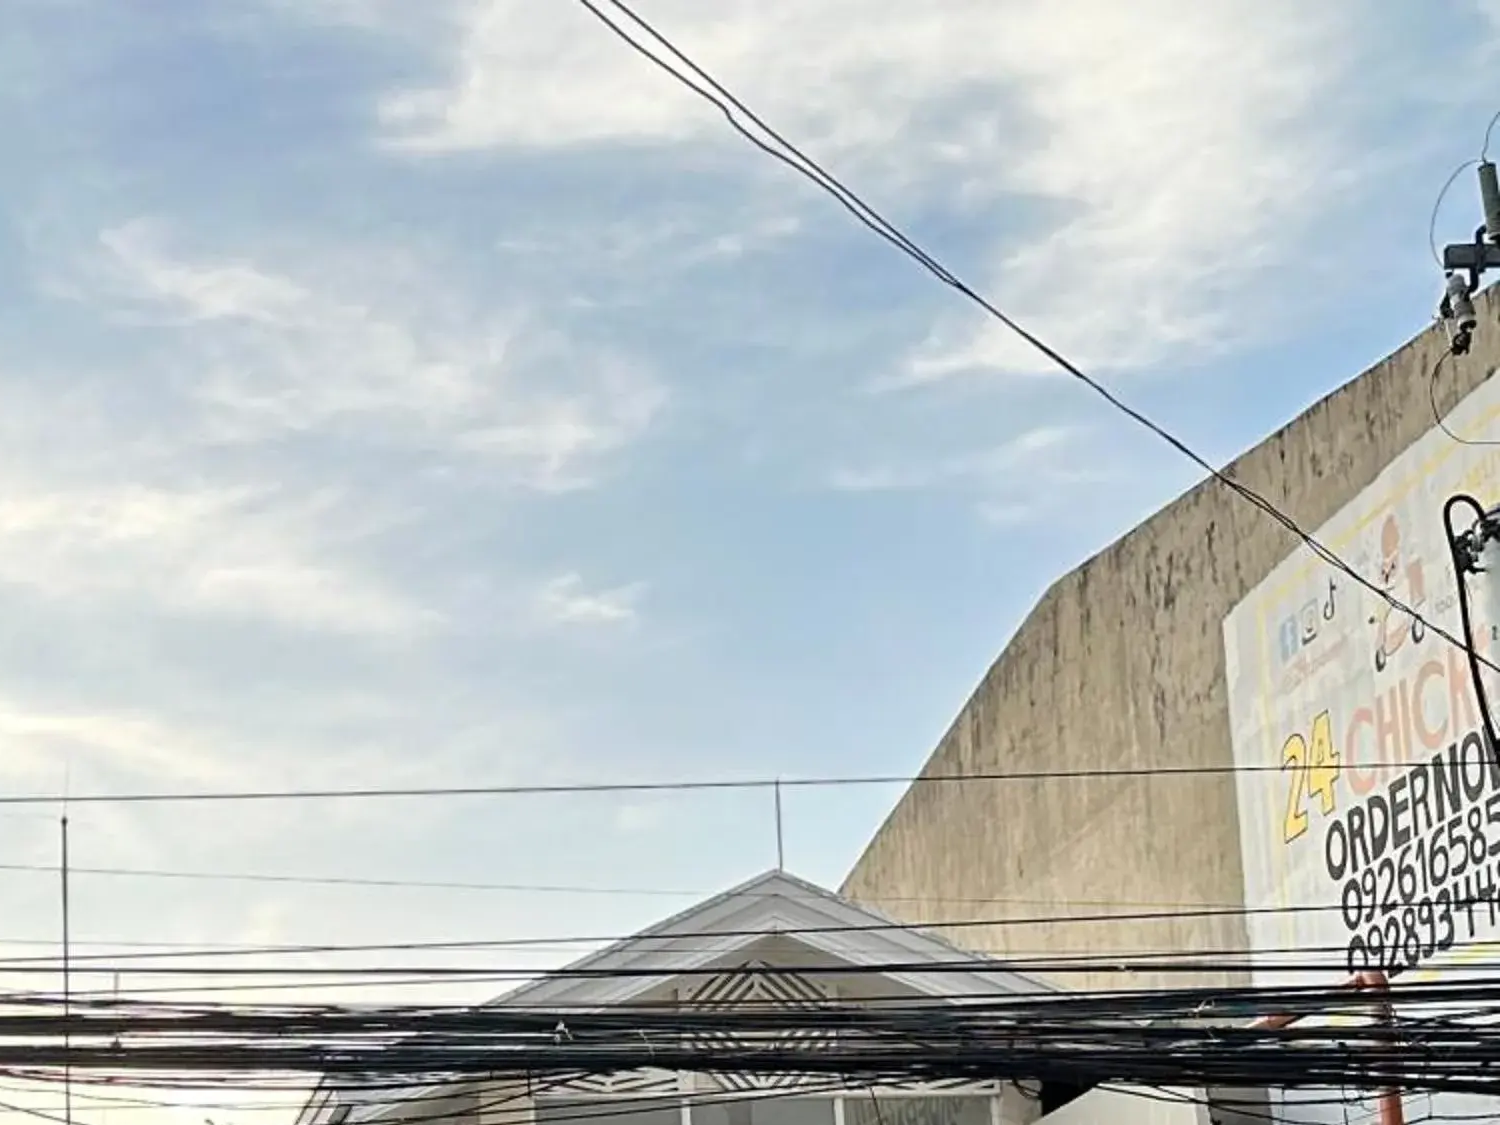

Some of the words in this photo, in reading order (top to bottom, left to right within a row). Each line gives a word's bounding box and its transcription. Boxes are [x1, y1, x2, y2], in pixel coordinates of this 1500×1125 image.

[1281, 709, 1340, 844] 24
[1345, 640, 1488, 797] CHICK
[1348, 862, 1500, 978] 09289344
